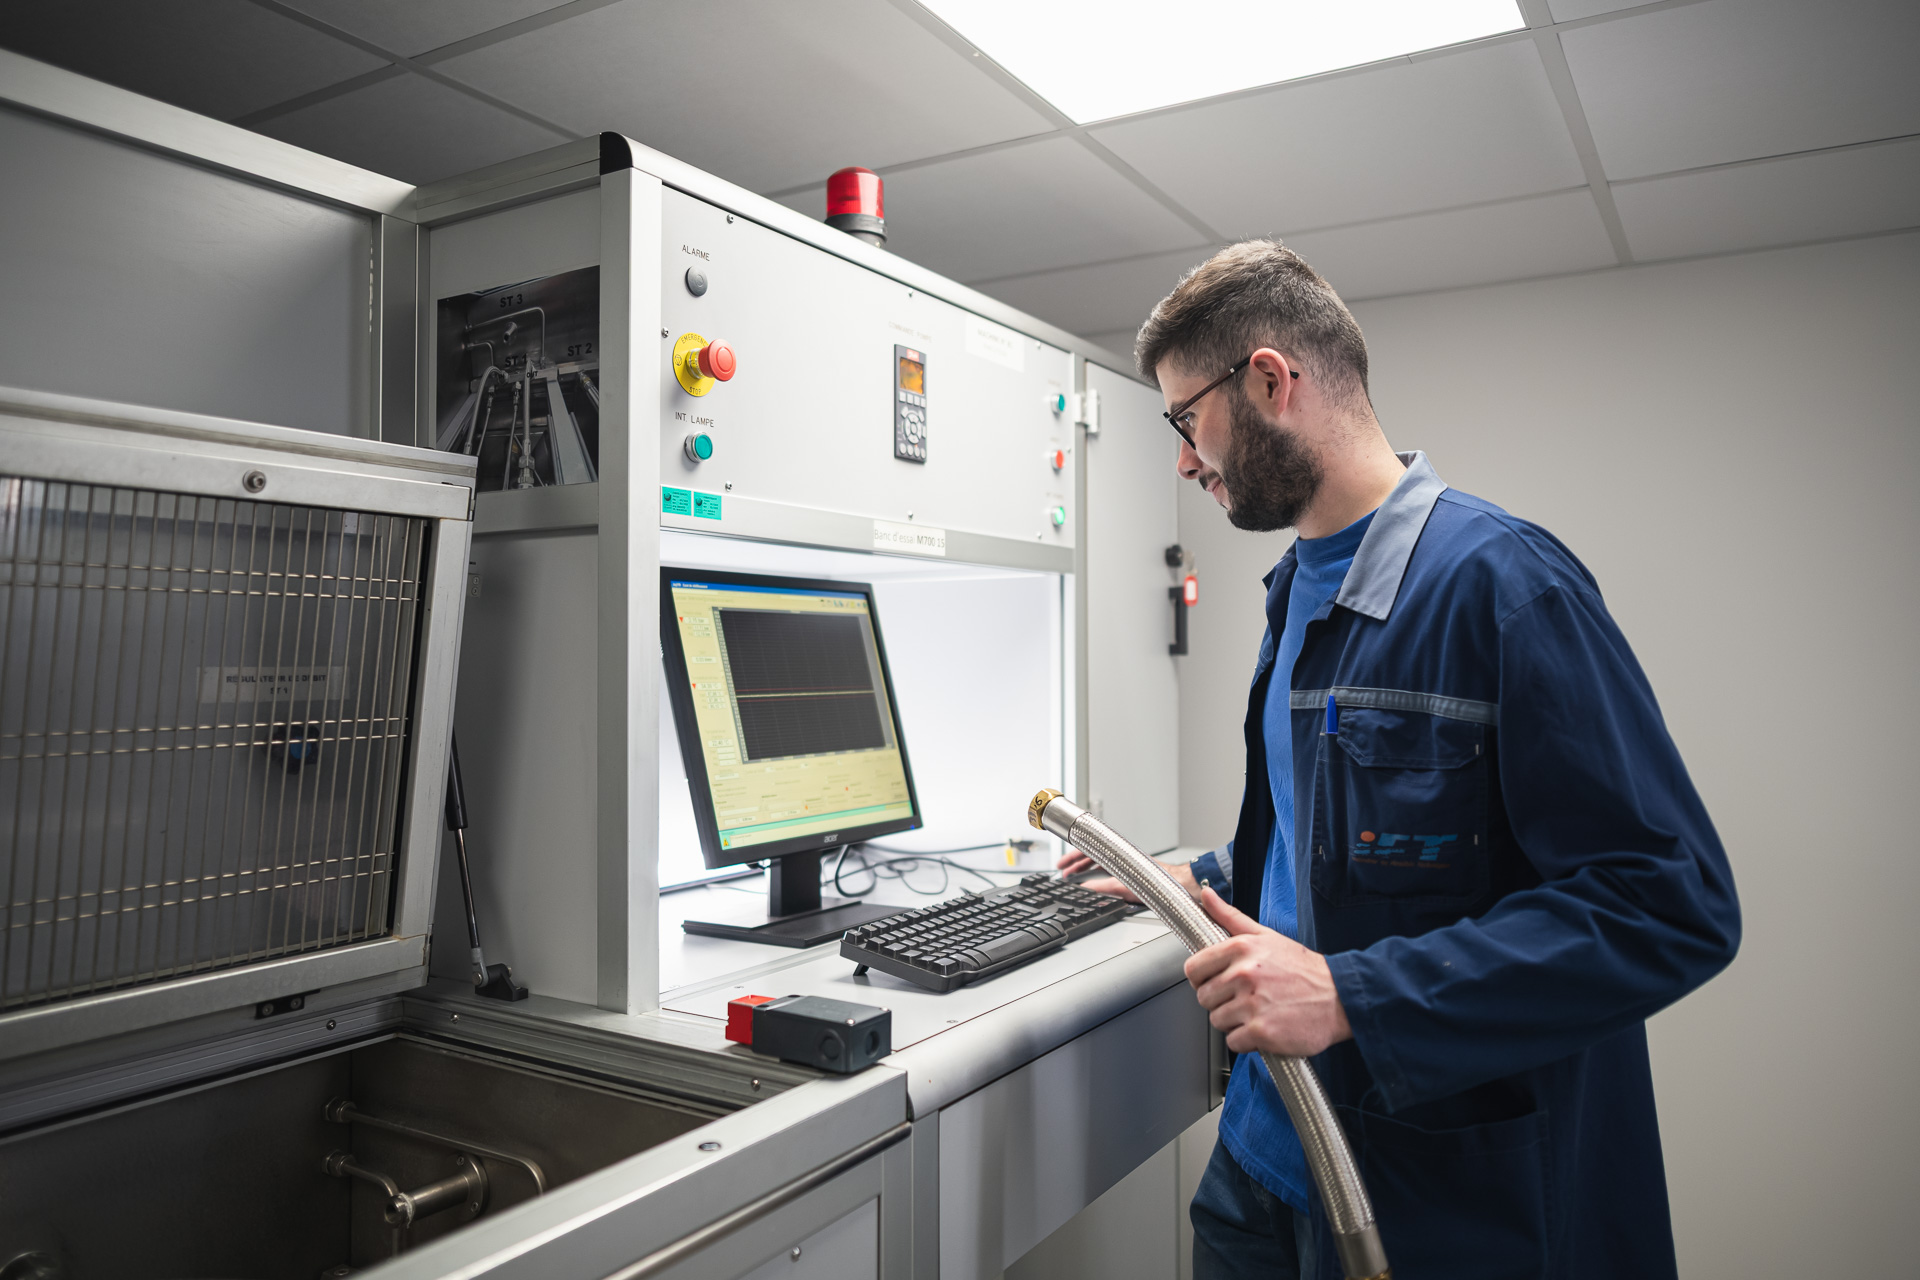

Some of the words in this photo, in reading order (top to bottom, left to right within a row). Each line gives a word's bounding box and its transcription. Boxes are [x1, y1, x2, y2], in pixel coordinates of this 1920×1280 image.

[682, 244, 710, 262] ALARME
[500, 295, 514, 308] ST
[517, 293, 523, 305] 3
[681, 333, 706, 347] EMERGENC
[567, 344, 582, 357] ST
[585, 342, 592, 354] 2
[505, 355, 518, 367] ST
[522, 353, 527, 364] 1
[689, 386, 702, 395] STOP
[675, 411, 687, 423] INT.
[691, 415, 715, 428] LAMPE
[874, 529, 891, 542] Banc
[917, 535, 936, 547] M700
[938, 538, 945, 548] 15
[824, 834, 839, 843] acer
